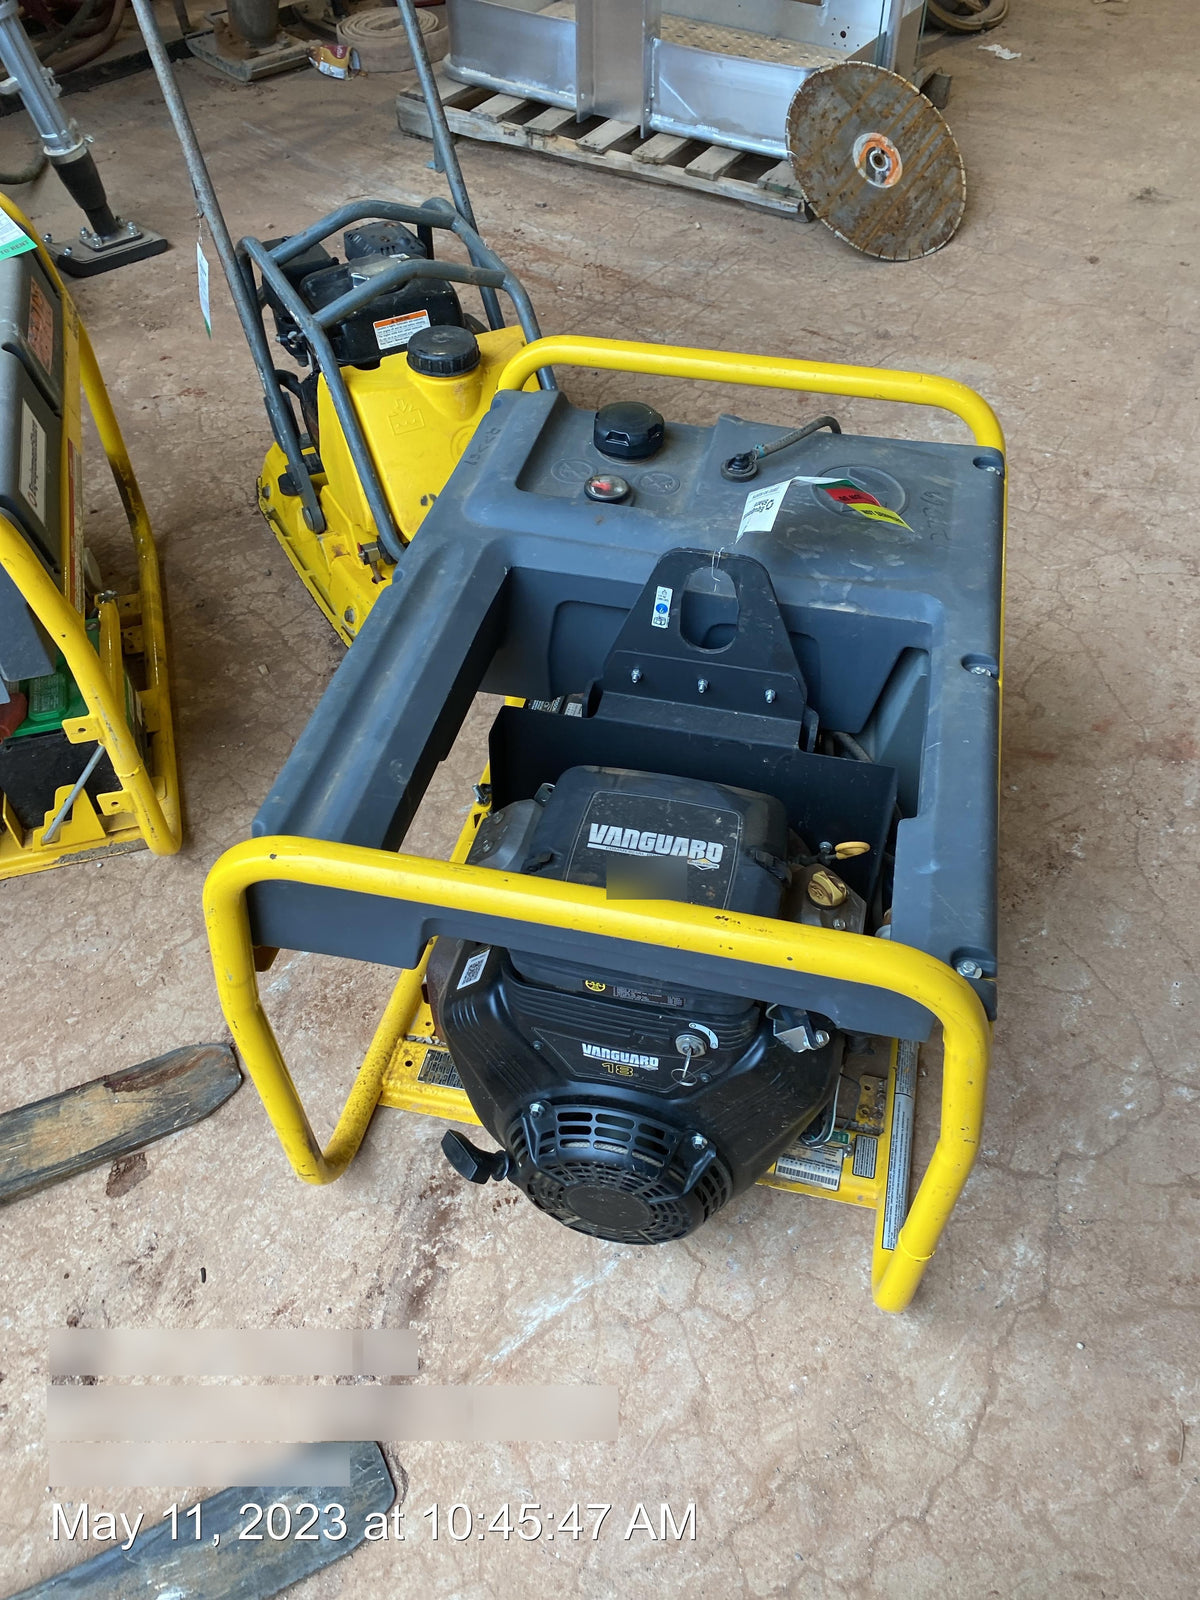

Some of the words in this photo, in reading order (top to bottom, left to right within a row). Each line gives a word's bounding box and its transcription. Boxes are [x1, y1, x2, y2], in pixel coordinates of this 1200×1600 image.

[588, 823, 724, 863] VANGUARD
[581, 1043, 659, 1067] VANGUARD
[601, 1062, 634, 1077] 18
